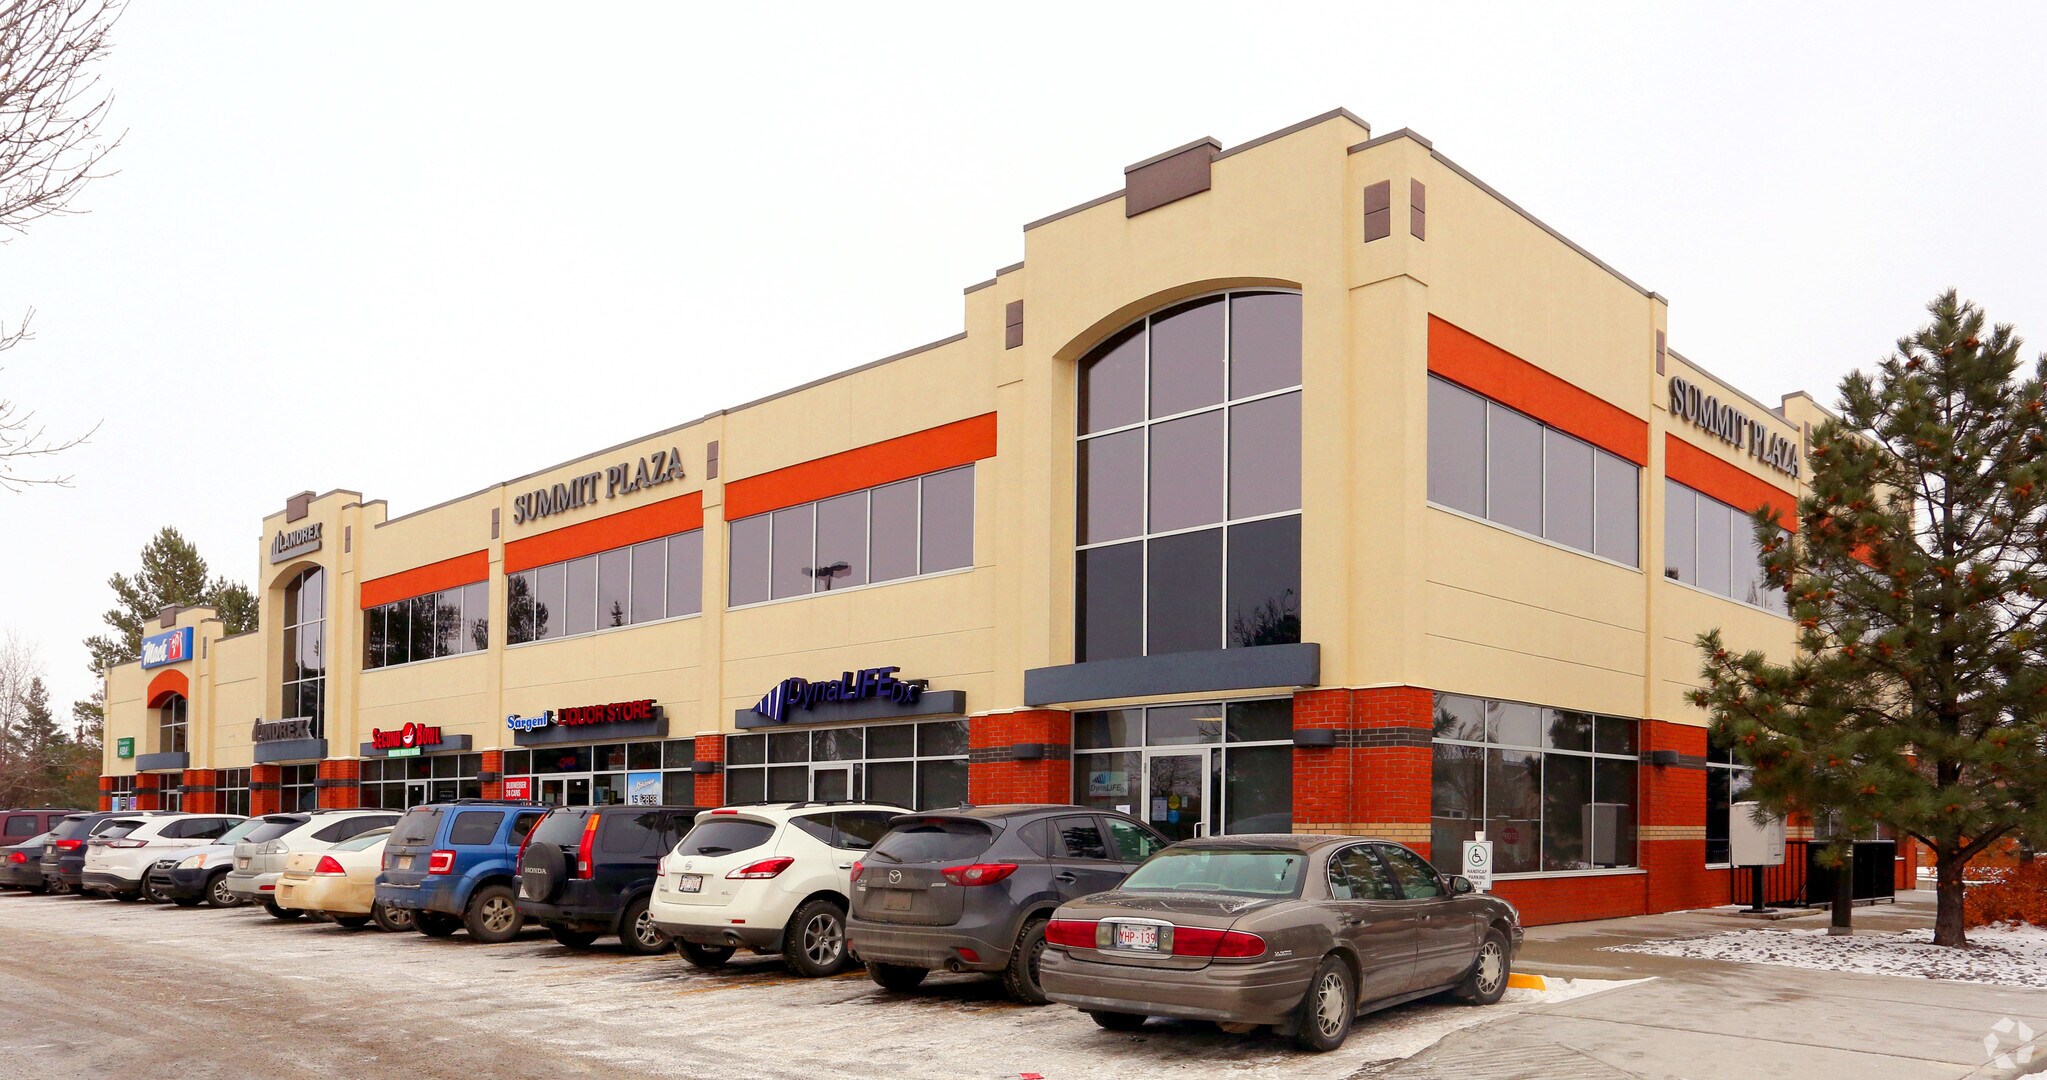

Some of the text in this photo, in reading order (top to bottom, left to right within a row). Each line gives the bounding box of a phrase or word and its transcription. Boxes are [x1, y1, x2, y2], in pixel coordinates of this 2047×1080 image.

[1669, 375, 1800, 480] SUMMIT PLAZA
[513, 446, 686, 525] SUMMIT PLAZA
[279, 522, 323, 551] LANDREX
[507, 699, 654, 732] Sargent LIQUOR STORE
[372, 723, 443, 749] SECOND BOWL
[524, 866, 547, 875] HONDA
